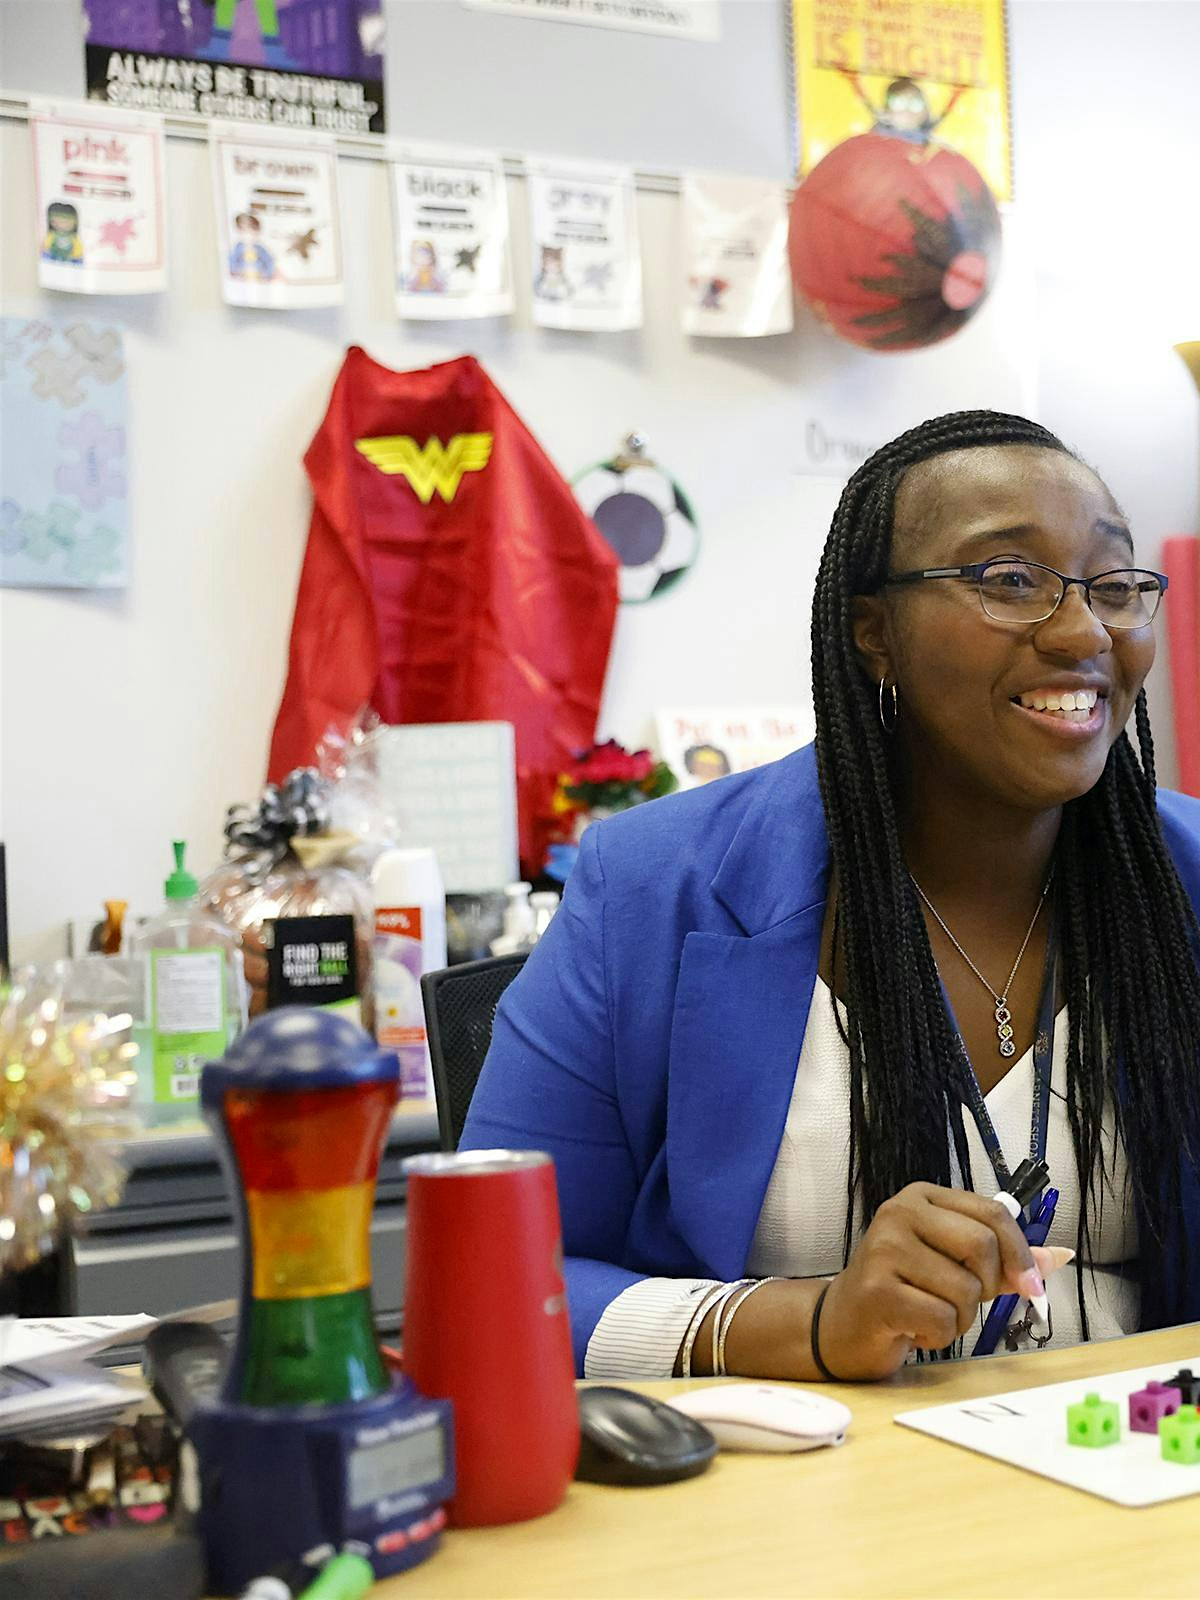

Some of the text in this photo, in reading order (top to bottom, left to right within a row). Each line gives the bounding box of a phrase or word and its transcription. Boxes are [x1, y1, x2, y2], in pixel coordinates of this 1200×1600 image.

[814, 31, 982, 85] IS RIGHT
[107, 51, 213, 92] ALWAYS
[214, 65, 248, 97] BE
[199, 92, 271, 121] OTHERS
[272, 100, 314, 127] CAN
[62, 136, 131, 165] pink
[233, 155, 319, 178] brown
[406, 172, 483, 200] black
[283, 942, 348, 961] FIND THE
